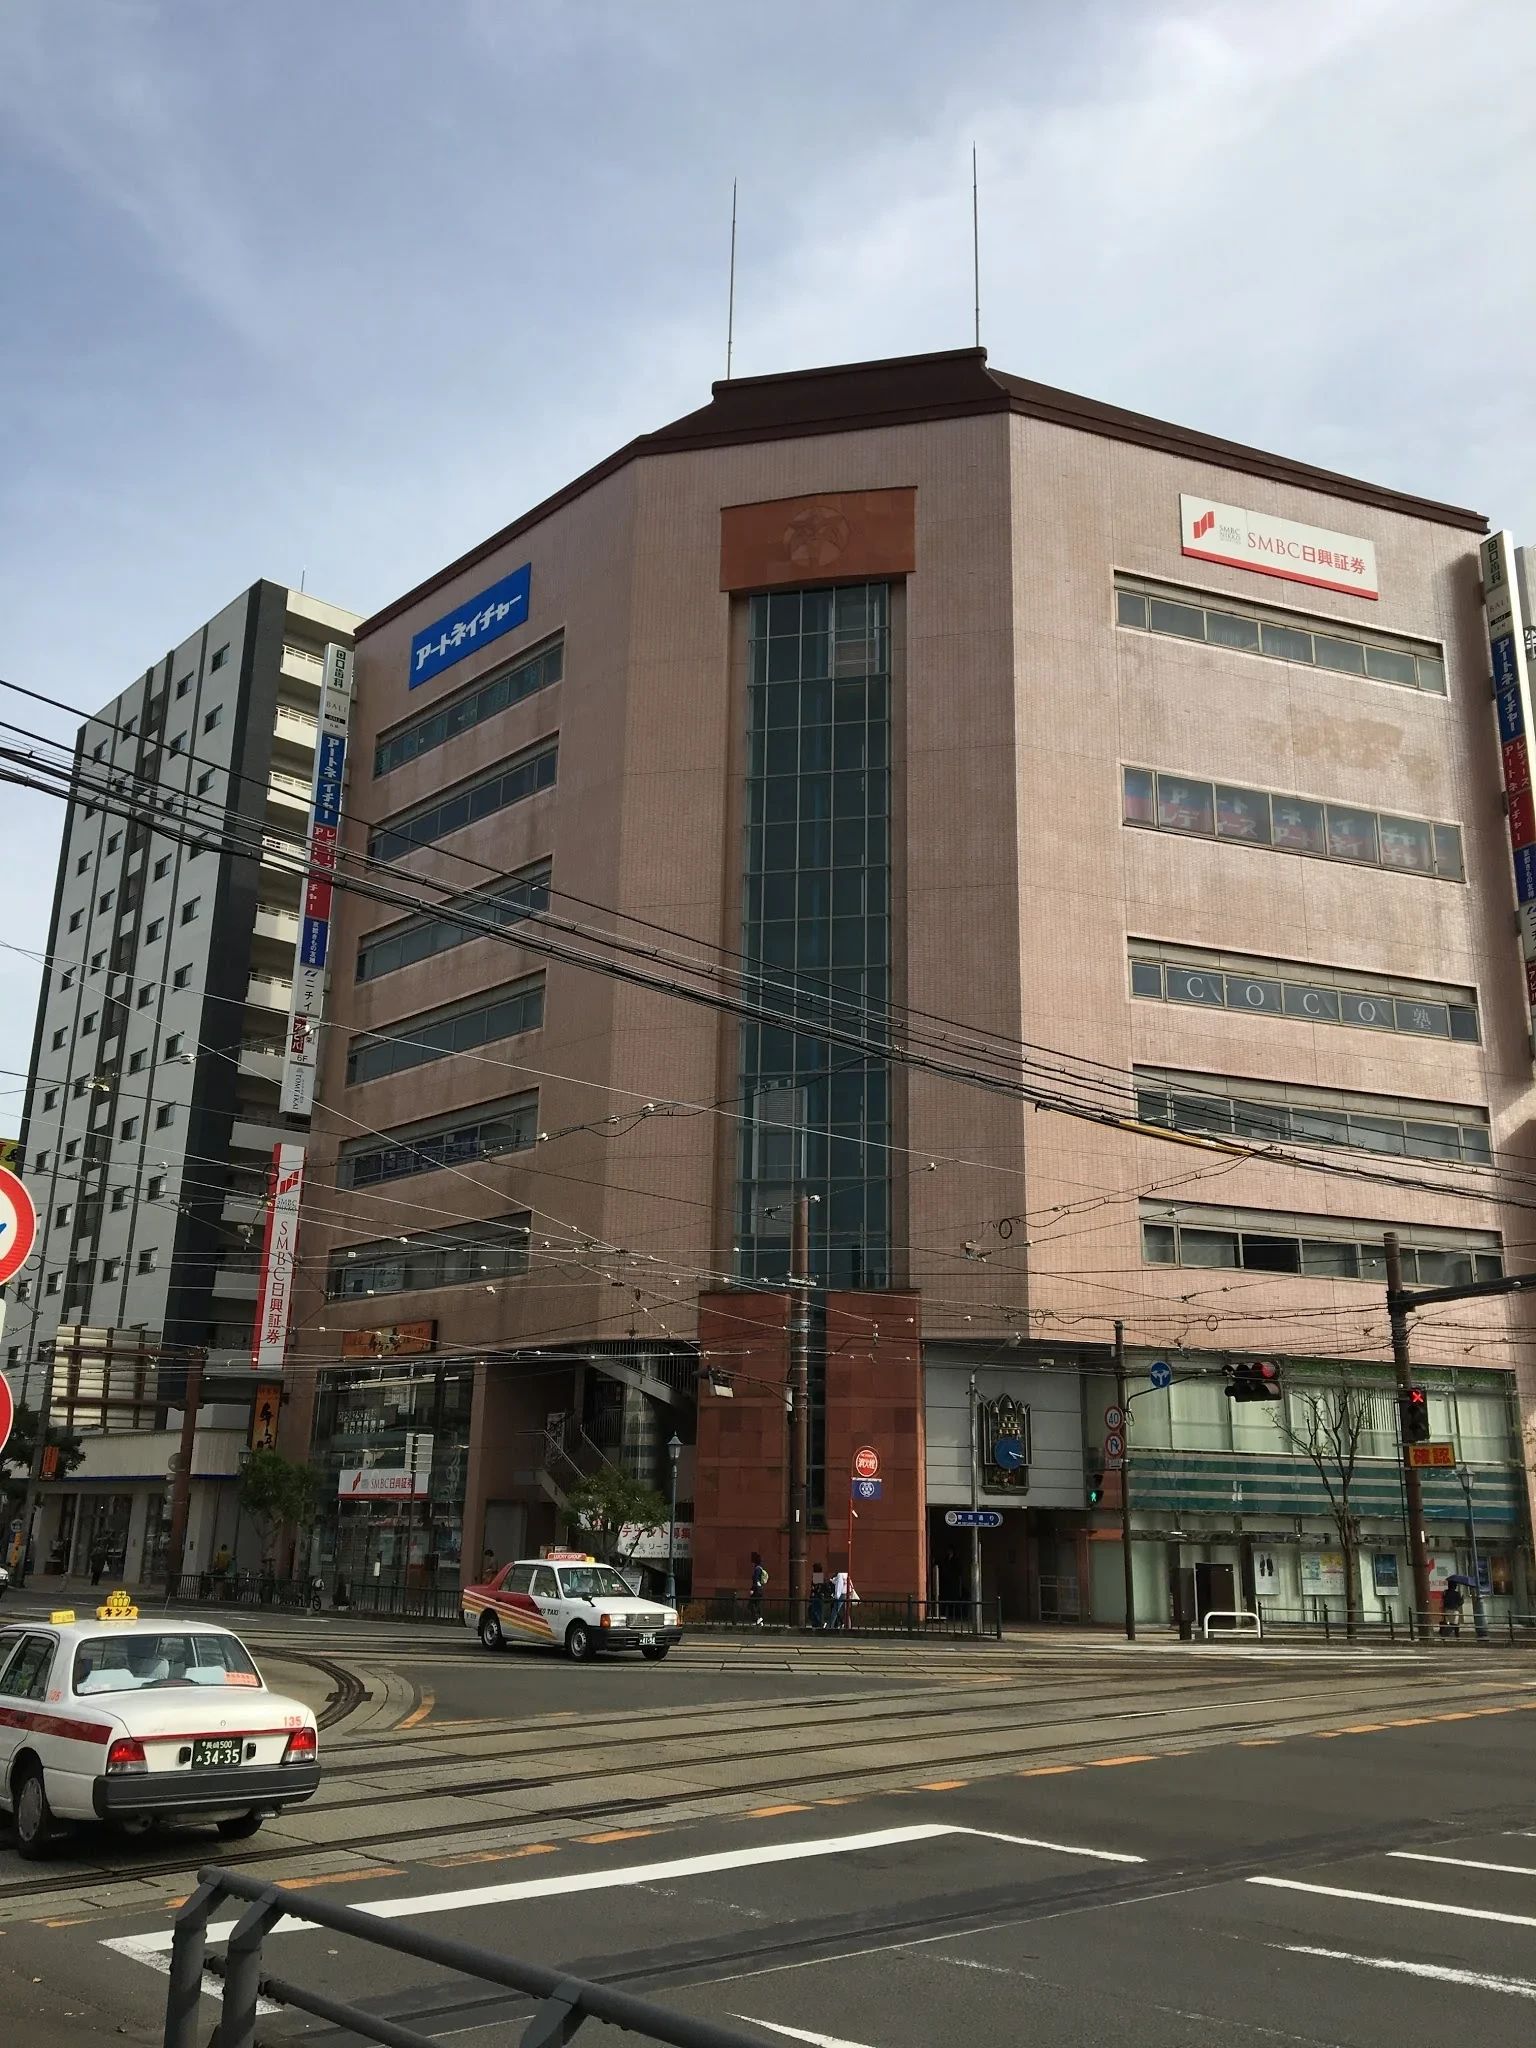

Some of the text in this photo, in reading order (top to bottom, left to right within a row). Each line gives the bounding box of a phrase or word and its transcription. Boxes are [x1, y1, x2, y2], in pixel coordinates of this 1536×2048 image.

[1247, 531, 1366, 575] SMBC日興証券
[416, 594, 522, 671] アートネイチャー
[1498, 637, 1518, 732] アートネイチャー
[322, 736, 340, 819] アートネイチャー
[1504, 744, 1522, 841] アートネイチャー
[303, 979, 315, 1011] ニチイ
[266, 1220, 289, 1344] SMBC日興証券
[1108, 1412, 1119, 1425] 40
[104, 1607, 133, 1617] キング
[283, 1716, 302, 1727] 135
[203, 1748, 240, 1766] 34-35
[219, 1740, 233, 1749] 500
